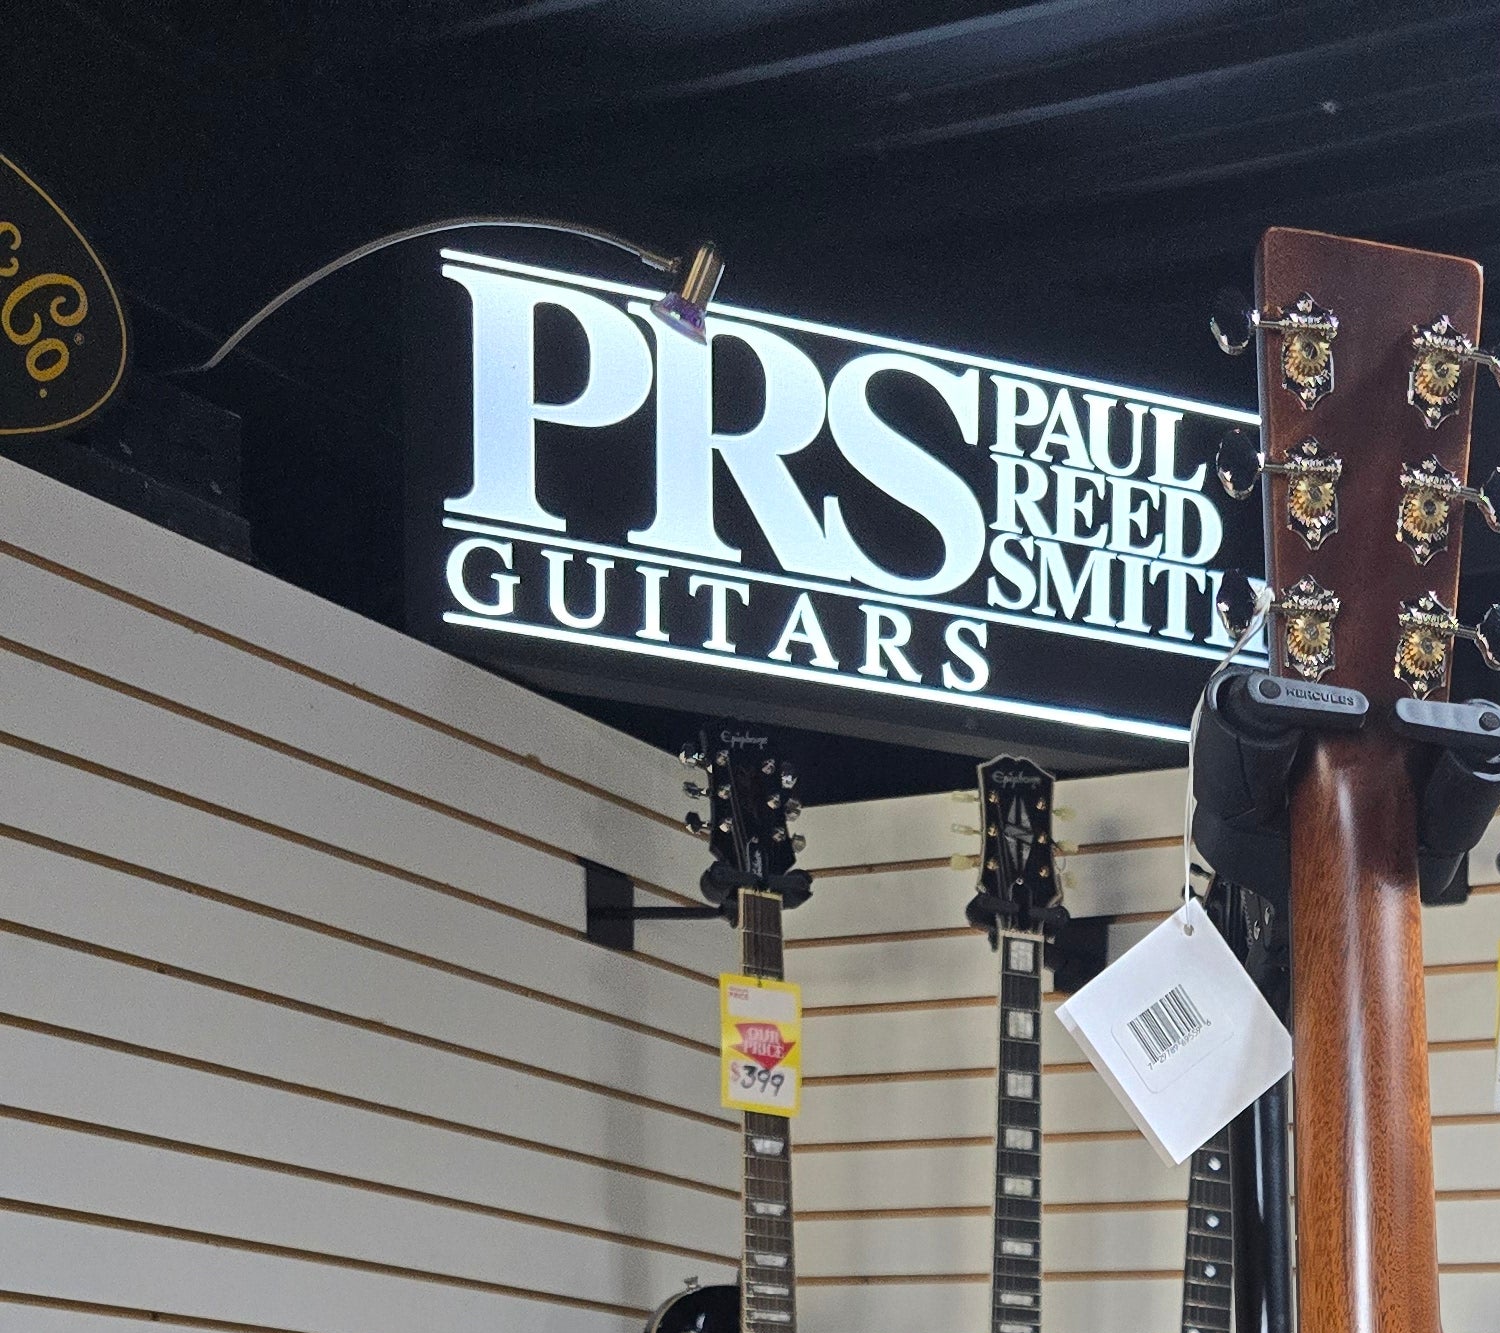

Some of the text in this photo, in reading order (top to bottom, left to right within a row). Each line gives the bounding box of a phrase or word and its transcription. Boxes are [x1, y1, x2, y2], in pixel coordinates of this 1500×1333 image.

[442, 263, 986, 597] PRS
[990, 374, 1207, 485] PAUL
[991, 453, 1222, 566] REED
[446, 539, 991, 693] GUITARS
[1285, 686, 1355, 706] HERCULES
[743, 1040, 785, 1059] PRICE
[748, 1027, 780, 1043] OUR
[730, 1061, 785, 1097] $399
